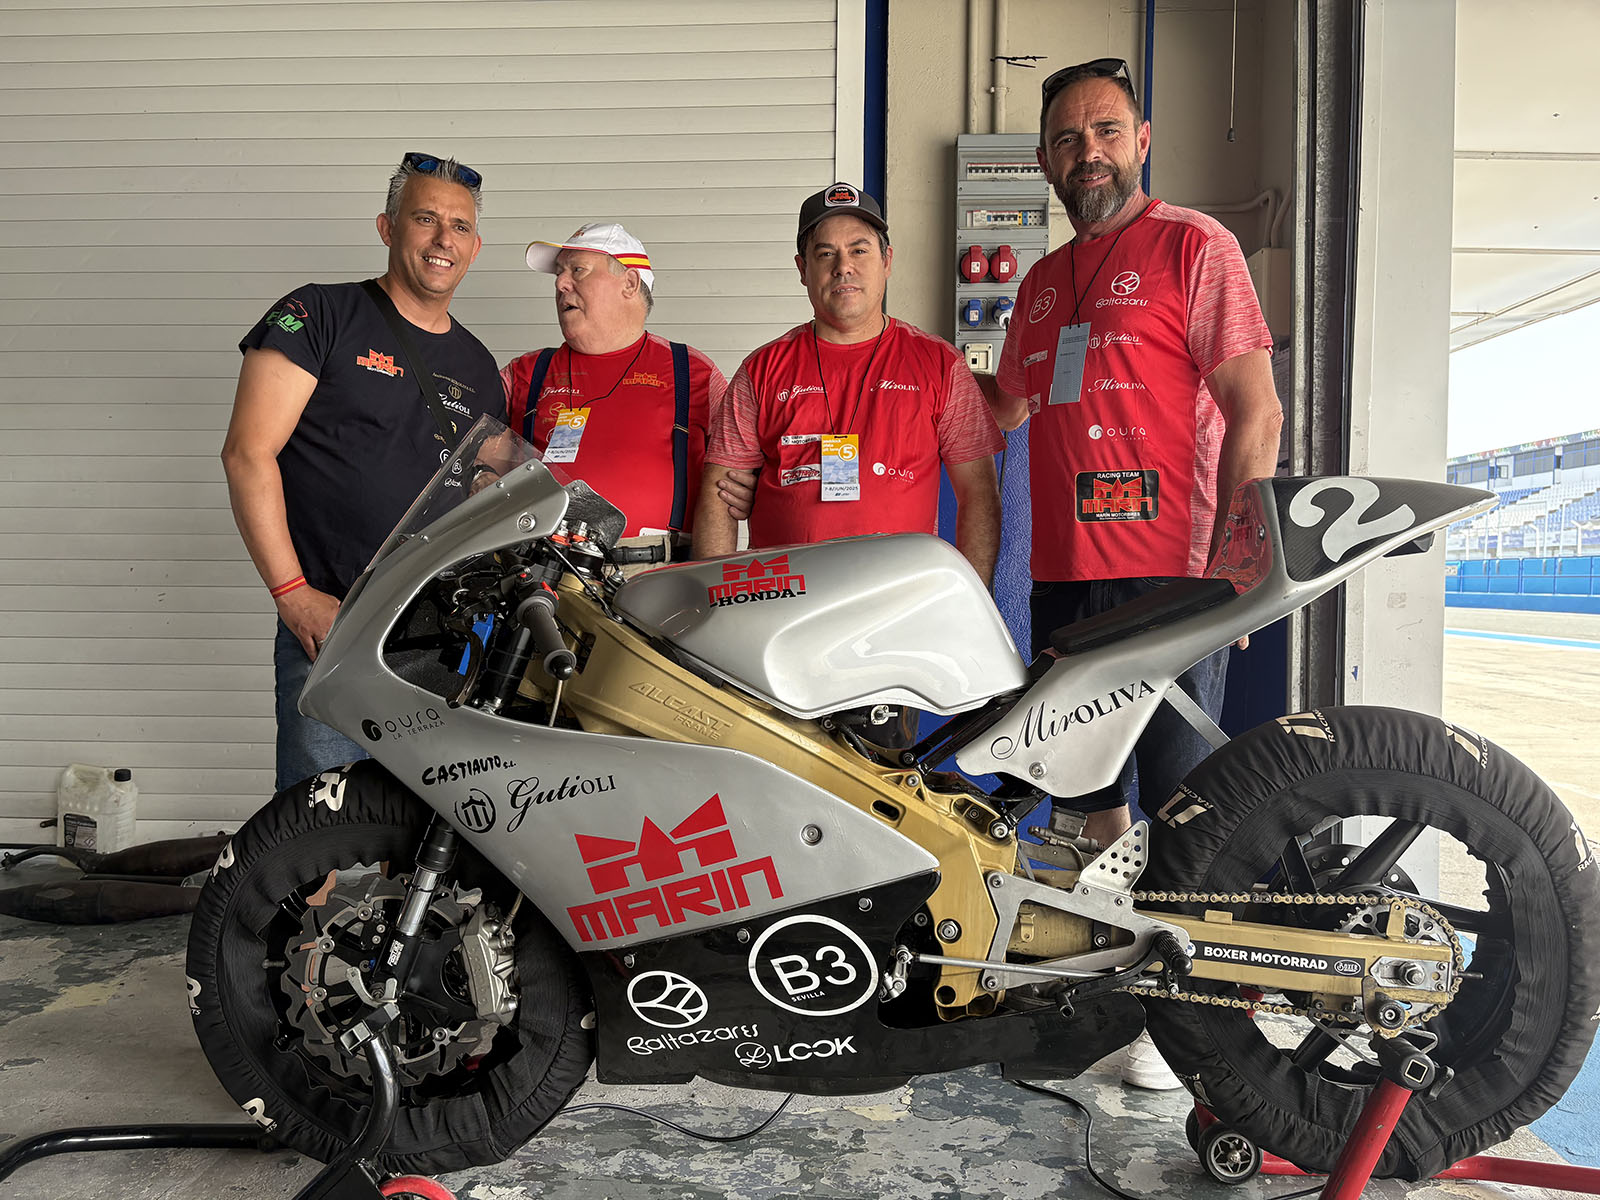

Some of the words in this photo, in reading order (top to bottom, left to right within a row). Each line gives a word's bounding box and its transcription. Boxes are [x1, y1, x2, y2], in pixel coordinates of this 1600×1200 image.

[572, 417, 583, 428] 5
[842, 446, 854, 459] 5
[1082, 497, 1152, 513] MARIN
[1289, 477, 1416, 563] 2
[708, 575, 806, 604] MARIN
[628, 682, 734, 731] ALCAST
[384, 708, 441, 733] oura
[393, 733, 404, 741] LA
[407, 720, 446, 737] TERRAZA
[674, 715, 721, 740] FRAME
[421, 755, 501, 785] CASTIAUTO
[567, 855, 784, 942] MARIN
[770, 945, 857, 996] B3
[1204, 946, 1248, 961] BOXER
[1251, 951, 1328, 970] MOTORRAD
[791, 990, 825, 1002] SEVILLA
[773, 1036, 857, 1063] LOOK
